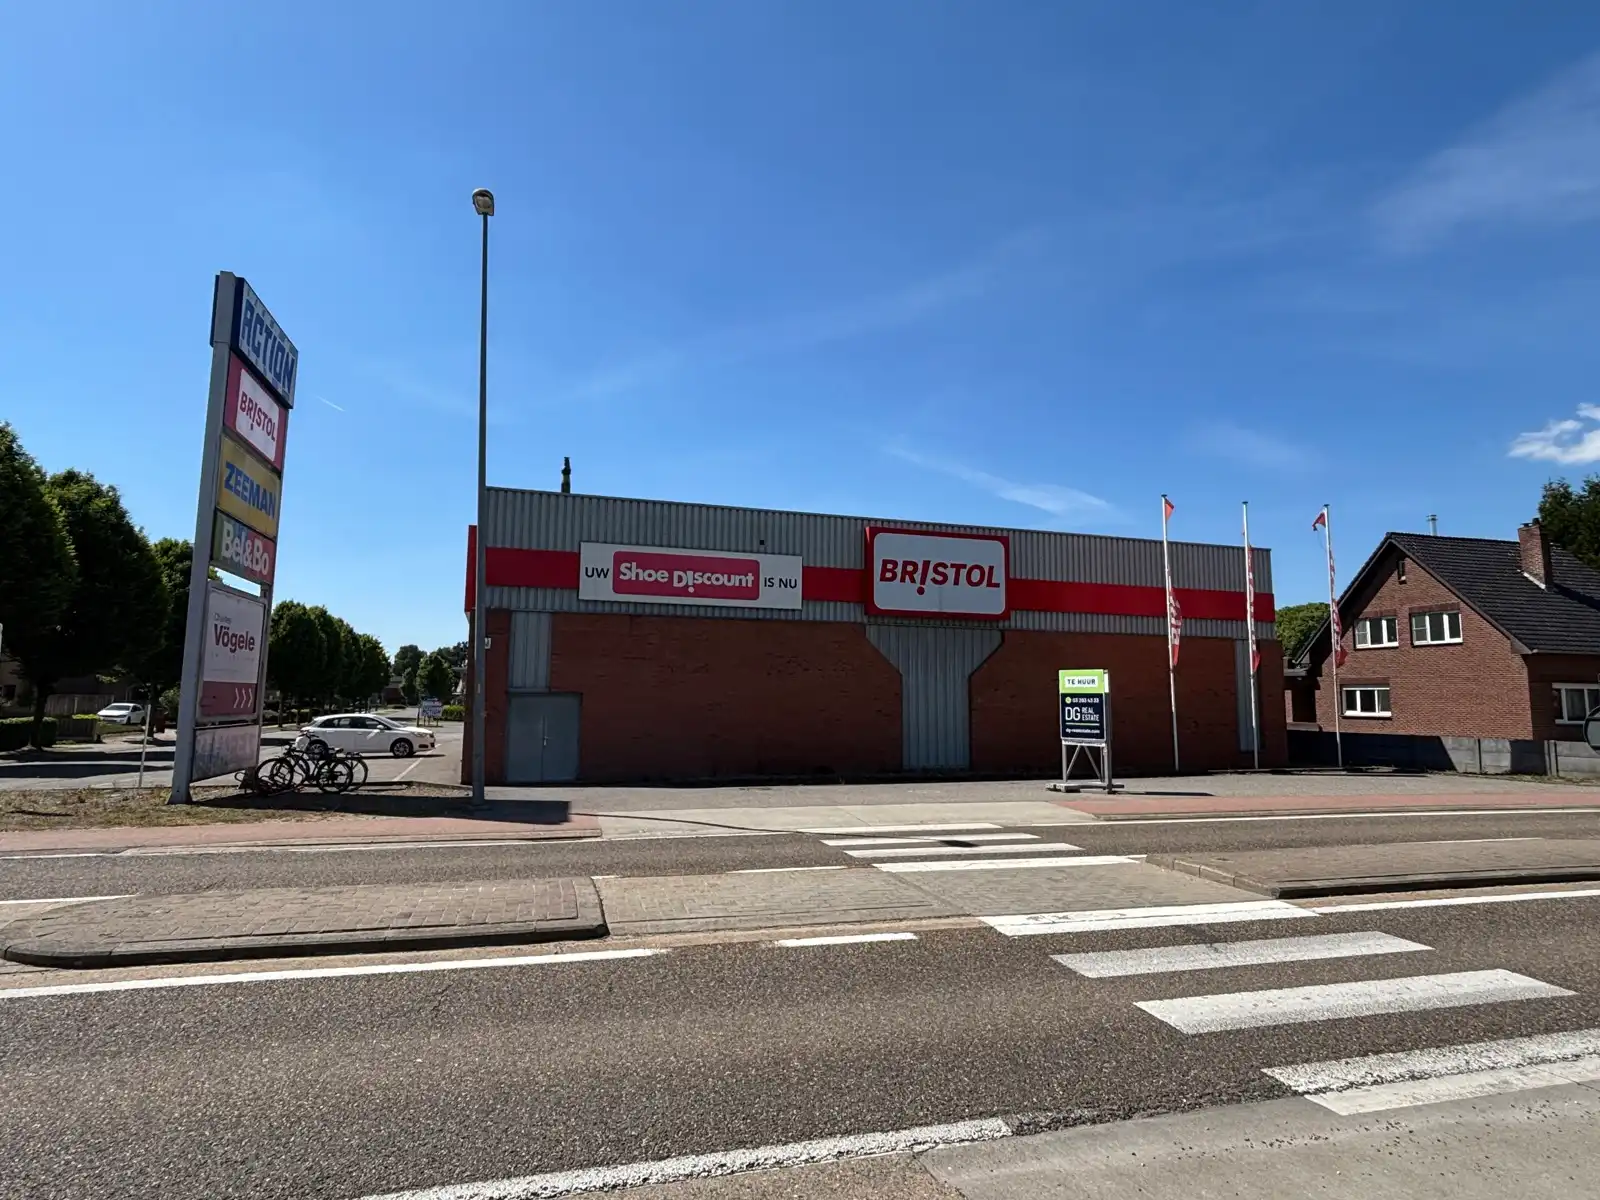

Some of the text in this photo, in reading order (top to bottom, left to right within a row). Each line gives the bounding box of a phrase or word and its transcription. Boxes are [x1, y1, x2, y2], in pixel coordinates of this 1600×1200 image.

[241, 298, 296, 394] ACTION
[224, 461, 276, 520] ZEEMAN
[221, 520, 270, 576] Bel&Bo
[584, 566, 610, 579] UW
[619, 562, 669, 583] Shoe
[763, 576, 775, 588] IS
[778, 577, 798, 589] NU
[214, 623, 256, 654] Vögele
[1065, 706, 1081, 721] DG
[1081, 706, 1094, 714] REAL
[1081, 714, 1100, 722] ESTATE
